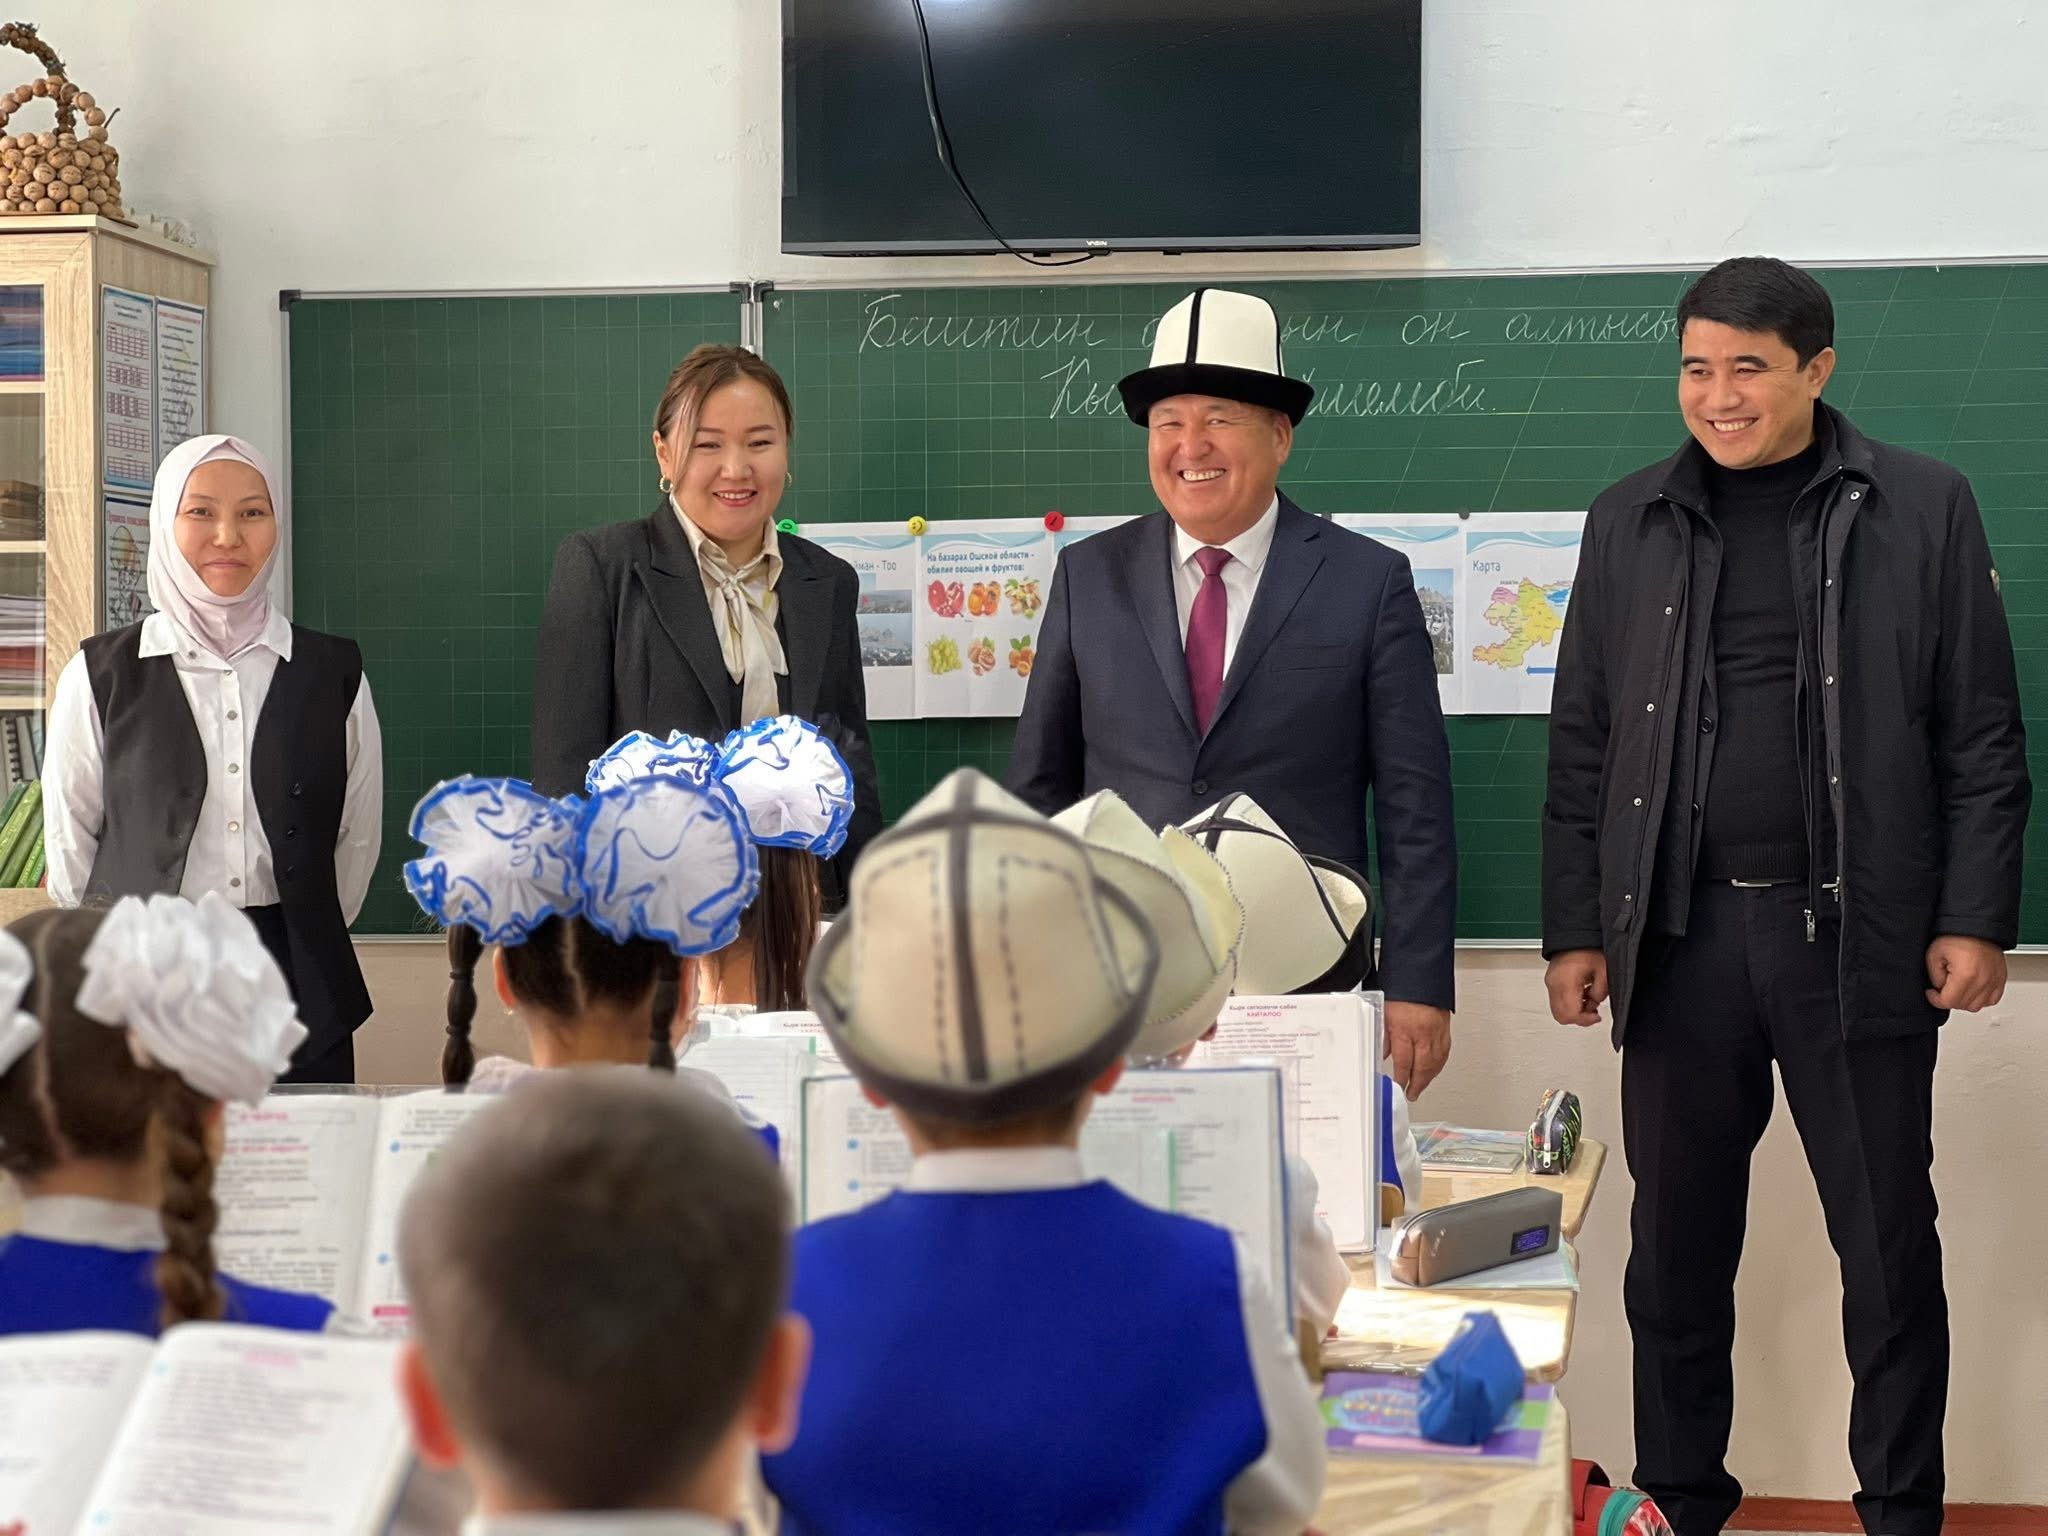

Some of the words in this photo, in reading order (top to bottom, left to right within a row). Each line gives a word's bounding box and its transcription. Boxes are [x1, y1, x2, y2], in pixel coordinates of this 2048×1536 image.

[859, 294, 1104, 353] Бештин
[1402, 311, 1471, 345] он
[938, 552, 967, 562] базарах
[969, 551, 998, 561] Ошской
[1000, 550, 1029, 560] области
[1472, 559, 1501, 574] Карта
